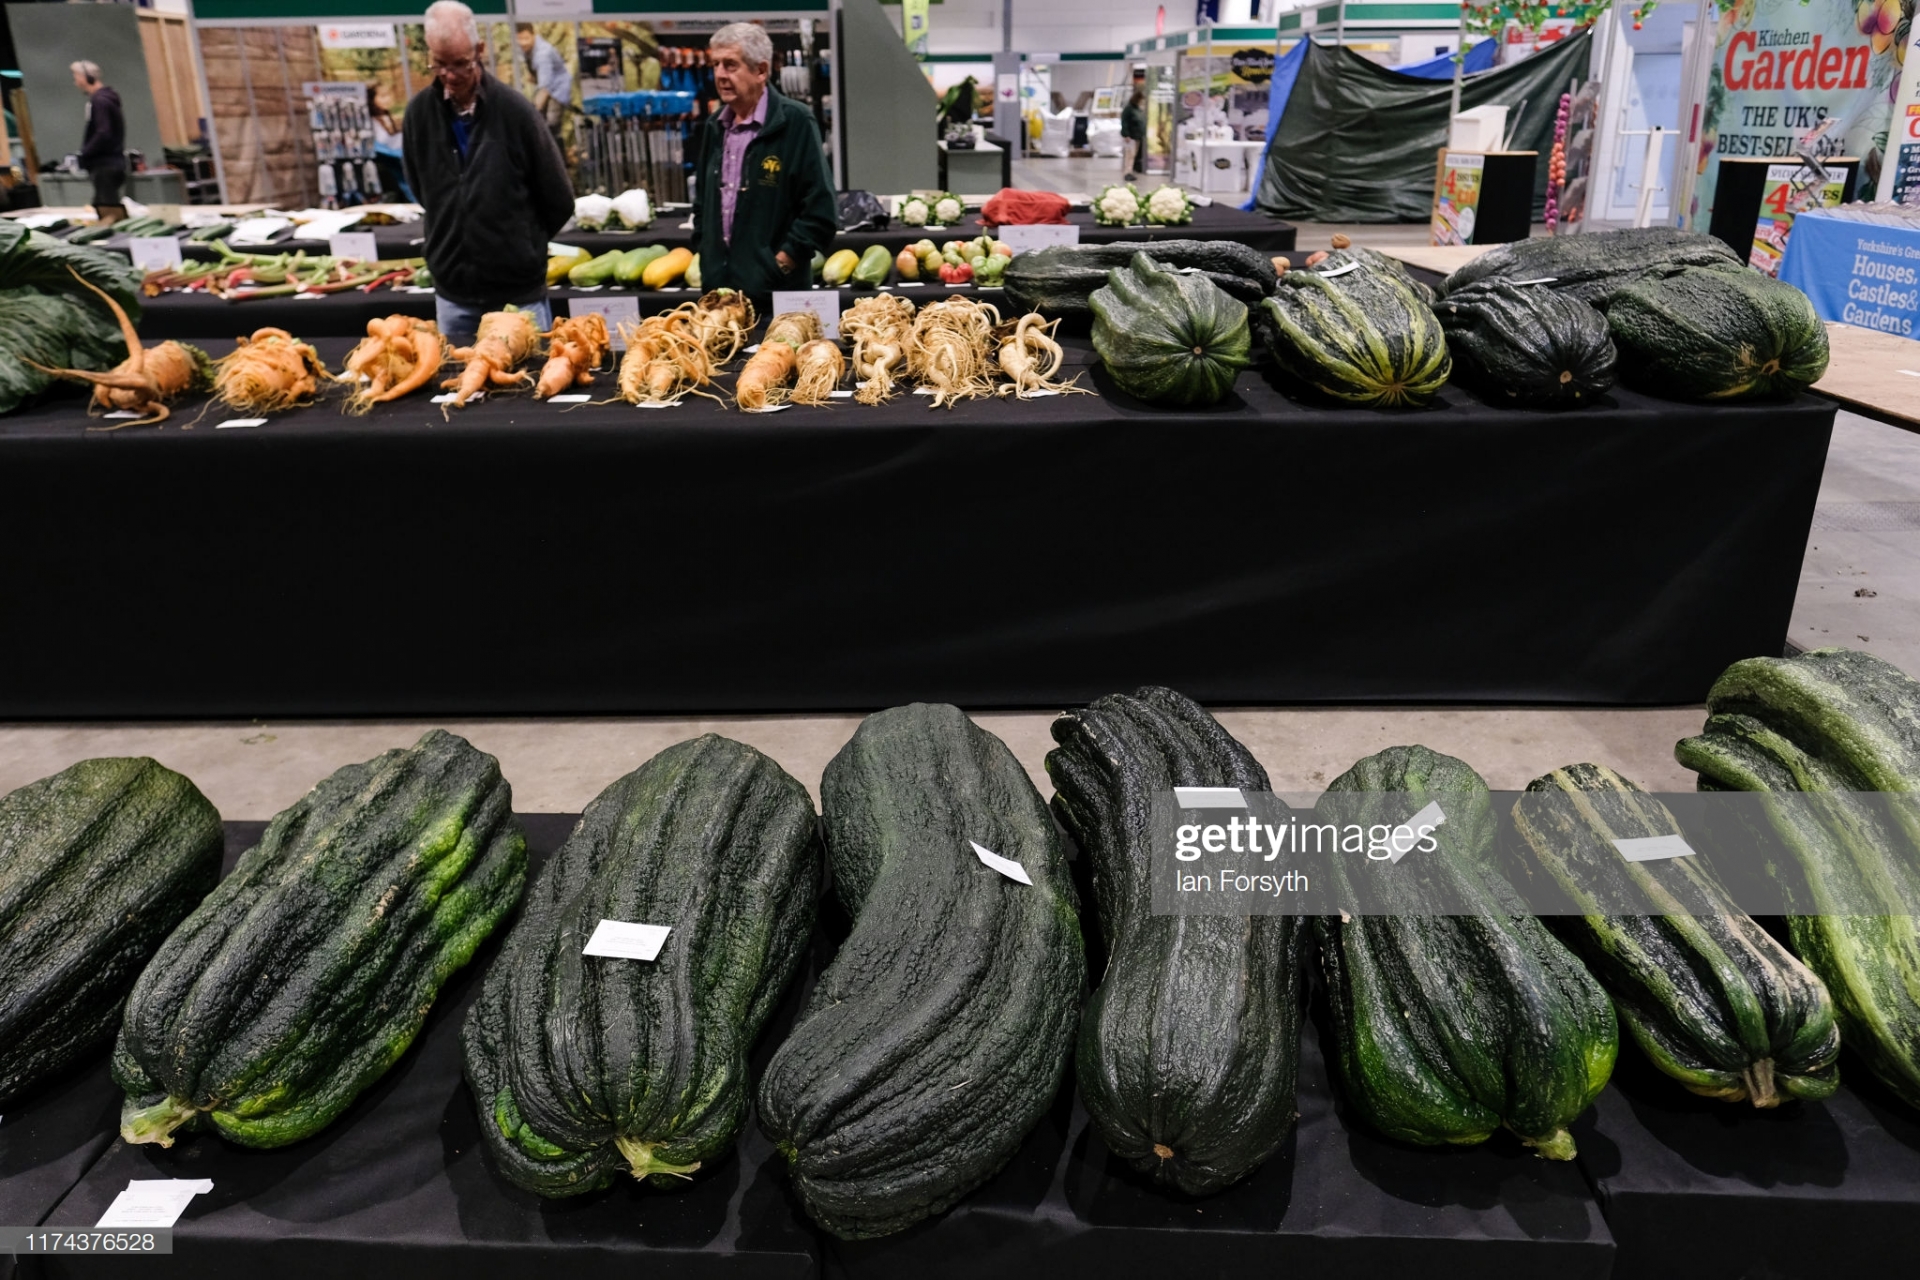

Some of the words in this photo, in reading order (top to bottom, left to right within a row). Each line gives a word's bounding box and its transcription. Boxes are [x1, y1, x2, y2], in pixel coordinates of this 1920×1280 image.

[1757, 28, 1810, 47] Kitchen
[1723, 30, 1871, 91] Garden
[1742, 106, 1779, 128] THE
[1784, 106, 1828, 129] UK'S
[1716, 134, 1846, 157] BEST-SEL
[1444, 168, 1457, 195] 4
[1765, 183, 1790, 215] 4
[1790, 188, 1840, 201] IES
[1857, 238, 1904, 257] Yorkshire's
[1852, 254, 1918, 285] Houses,
[1843, 302, 1912, 334] Gardens
